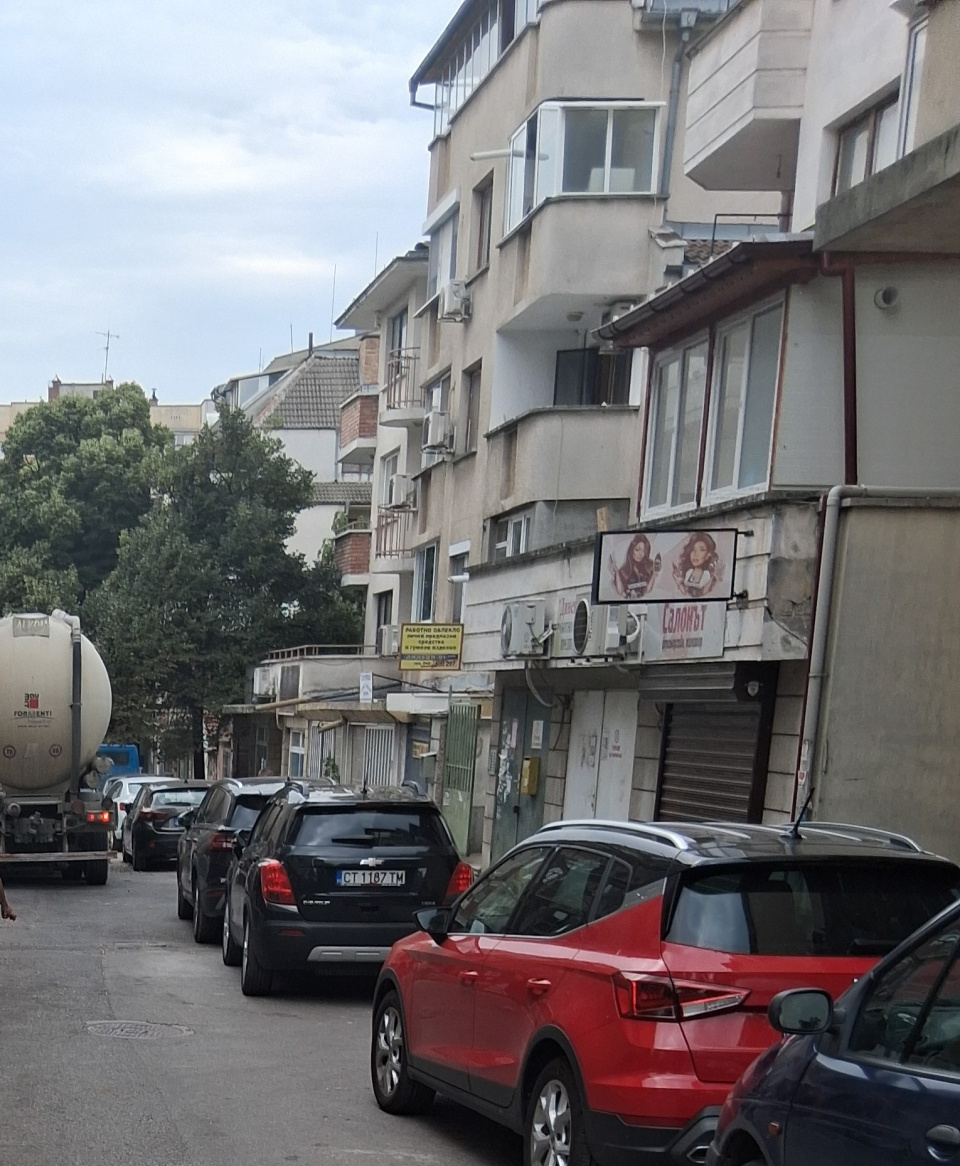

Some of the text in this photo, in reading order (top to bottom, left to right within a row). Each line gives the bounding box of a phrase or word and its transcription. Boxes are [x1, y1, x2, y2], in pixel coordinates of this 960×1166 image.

[343, 872, 404, 884] CT 1187 TM
